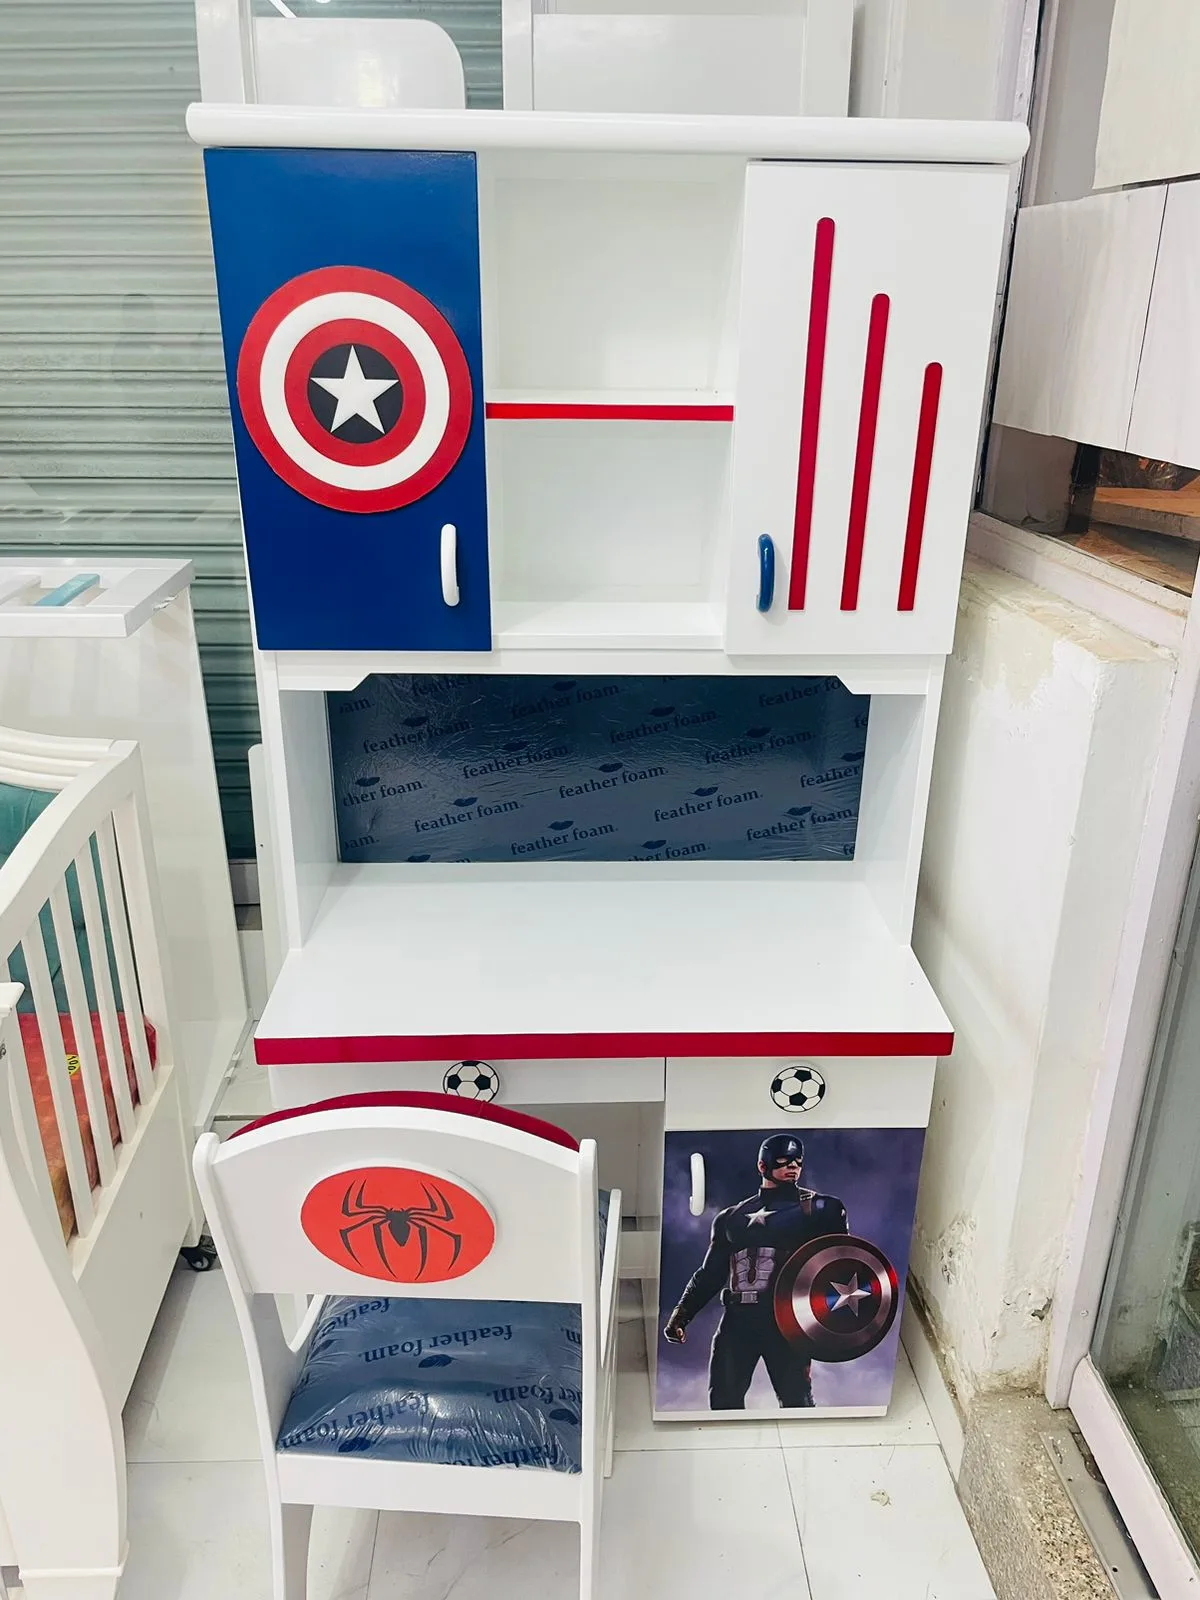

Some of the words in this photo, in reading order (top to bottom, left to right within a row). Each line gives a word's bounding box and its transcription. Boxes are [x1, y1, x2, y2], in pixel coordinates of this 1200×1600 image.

[758, 683, 822, 707] feather
[363, 730, 425, 754] feather
[609, 721, 671, 743] feather
[704, 741, 766, 764] feather
[462, 756, 524, 779] feather
[800, 765, 860, 788] feather
[559, 776, 619, 799] feather
[414, 811, 474, 833] feather
[654, 800, 713, 822] feather
[746, 819, 806, 841] feather
[510, 834, 569, 855] feather
[429, 1324, 514, 1349] feather
[345, 1392, 430, 1429] feather
